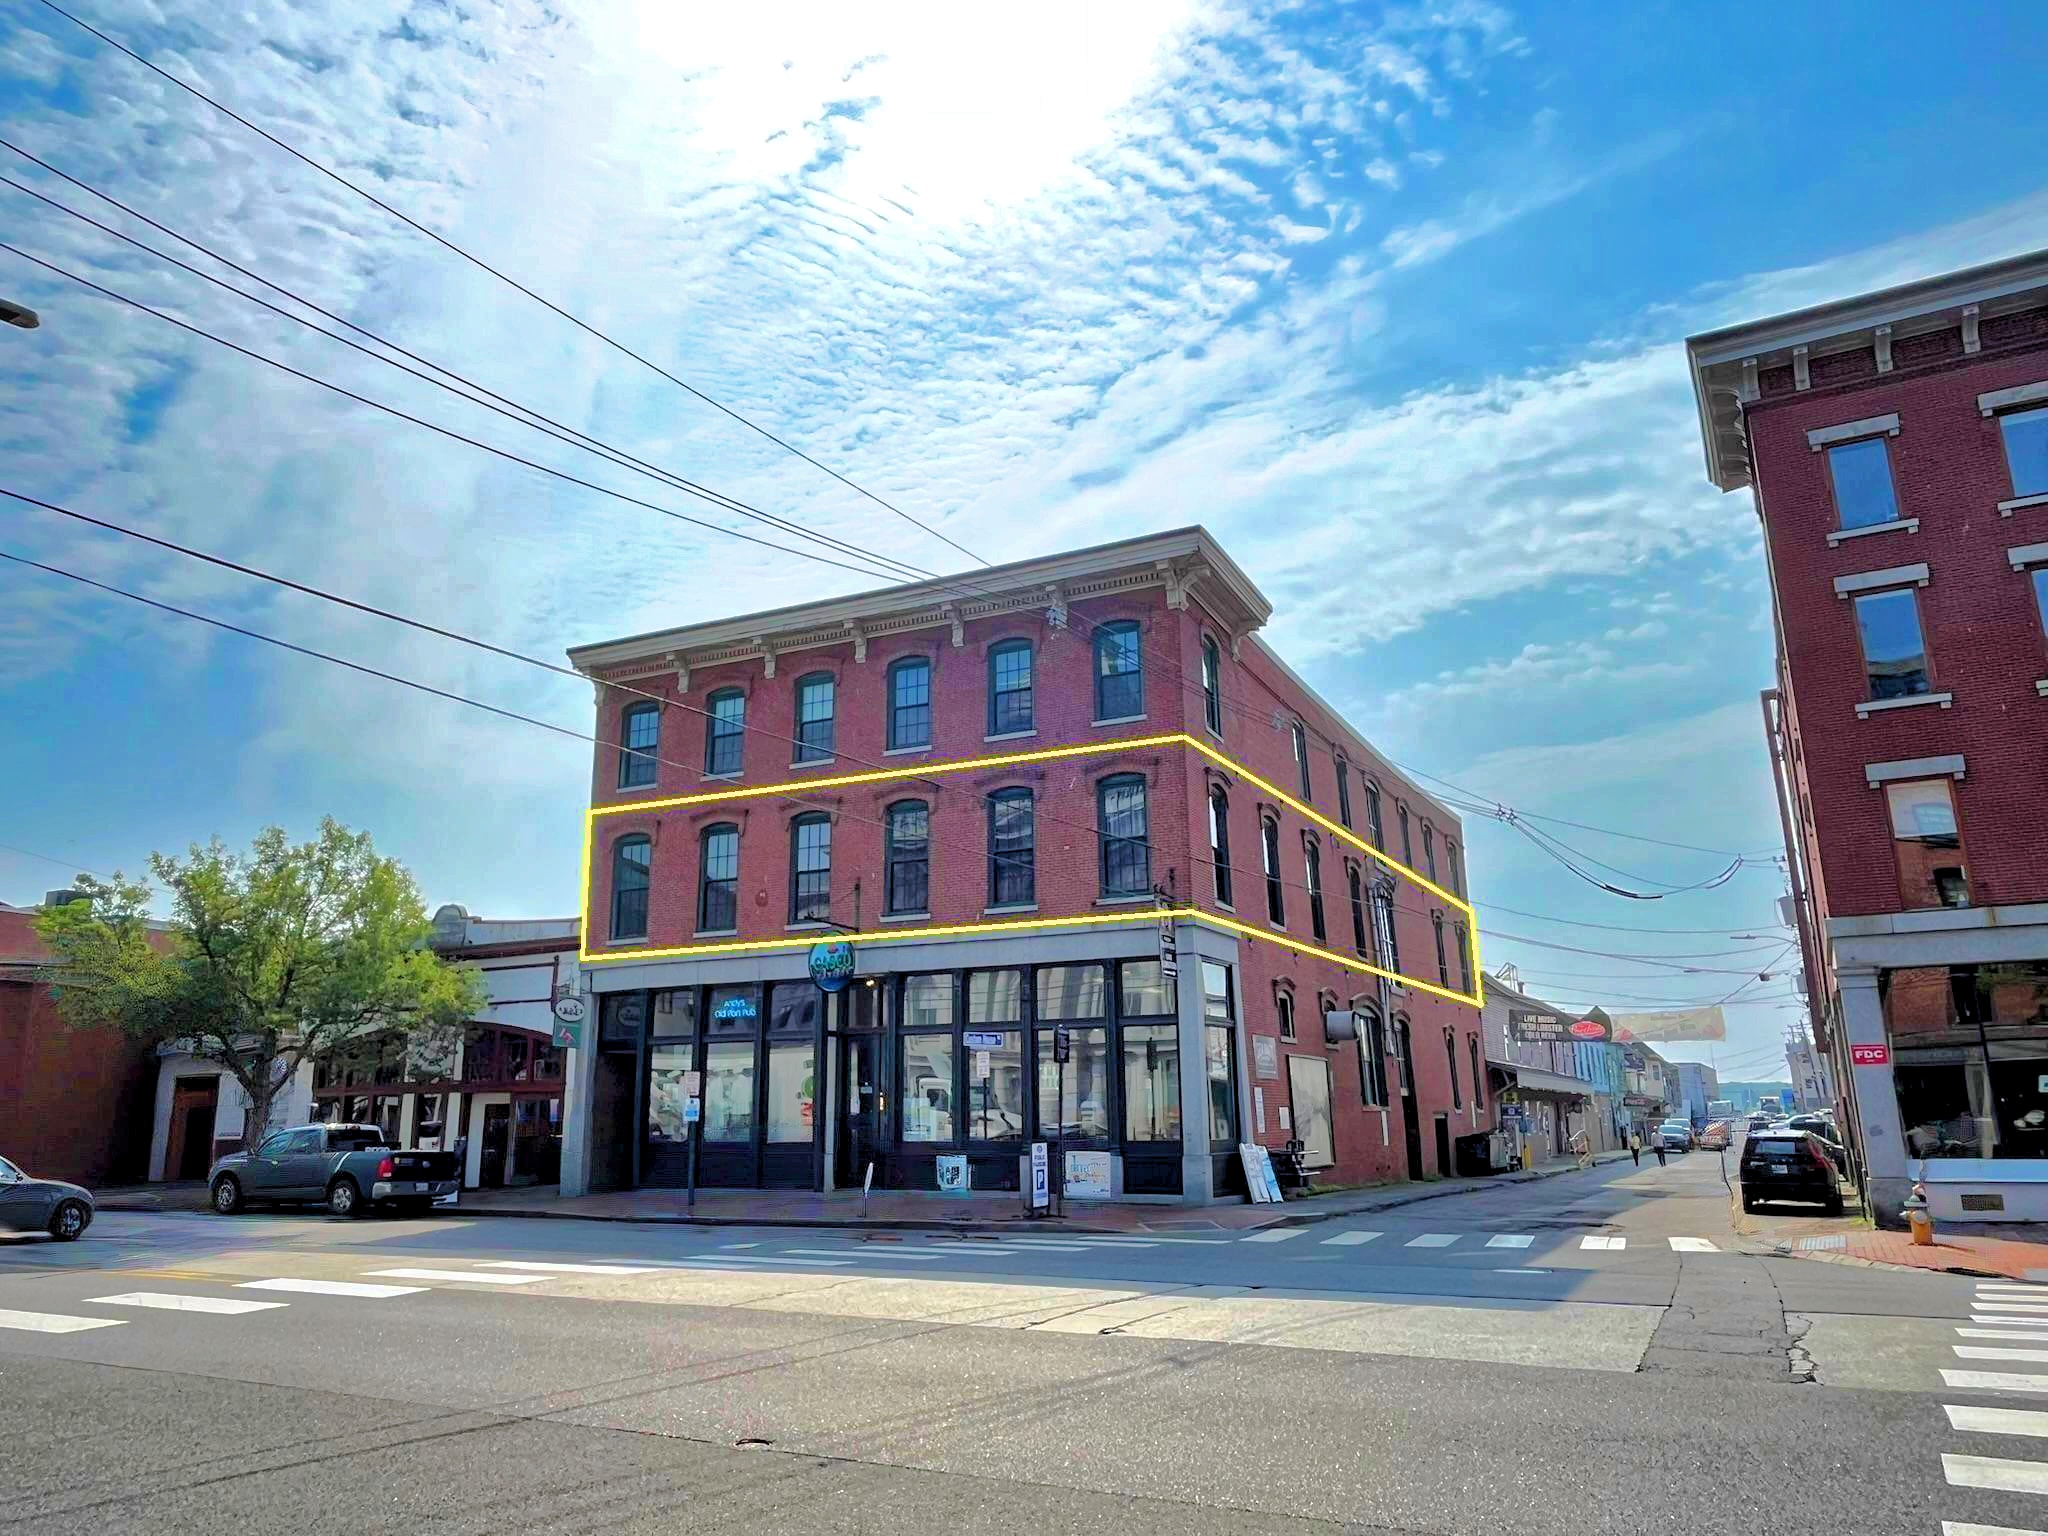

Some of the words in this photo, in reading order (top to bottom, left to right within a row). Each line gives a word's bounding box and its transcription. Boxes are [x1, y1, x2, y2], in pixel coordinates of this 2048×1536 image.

[1523, 1014, 1537, 1023] LIVE
[1537, 1023, 1564, 1032] LOBSTER
[1855, 1050, 1884, 1059] FDC
